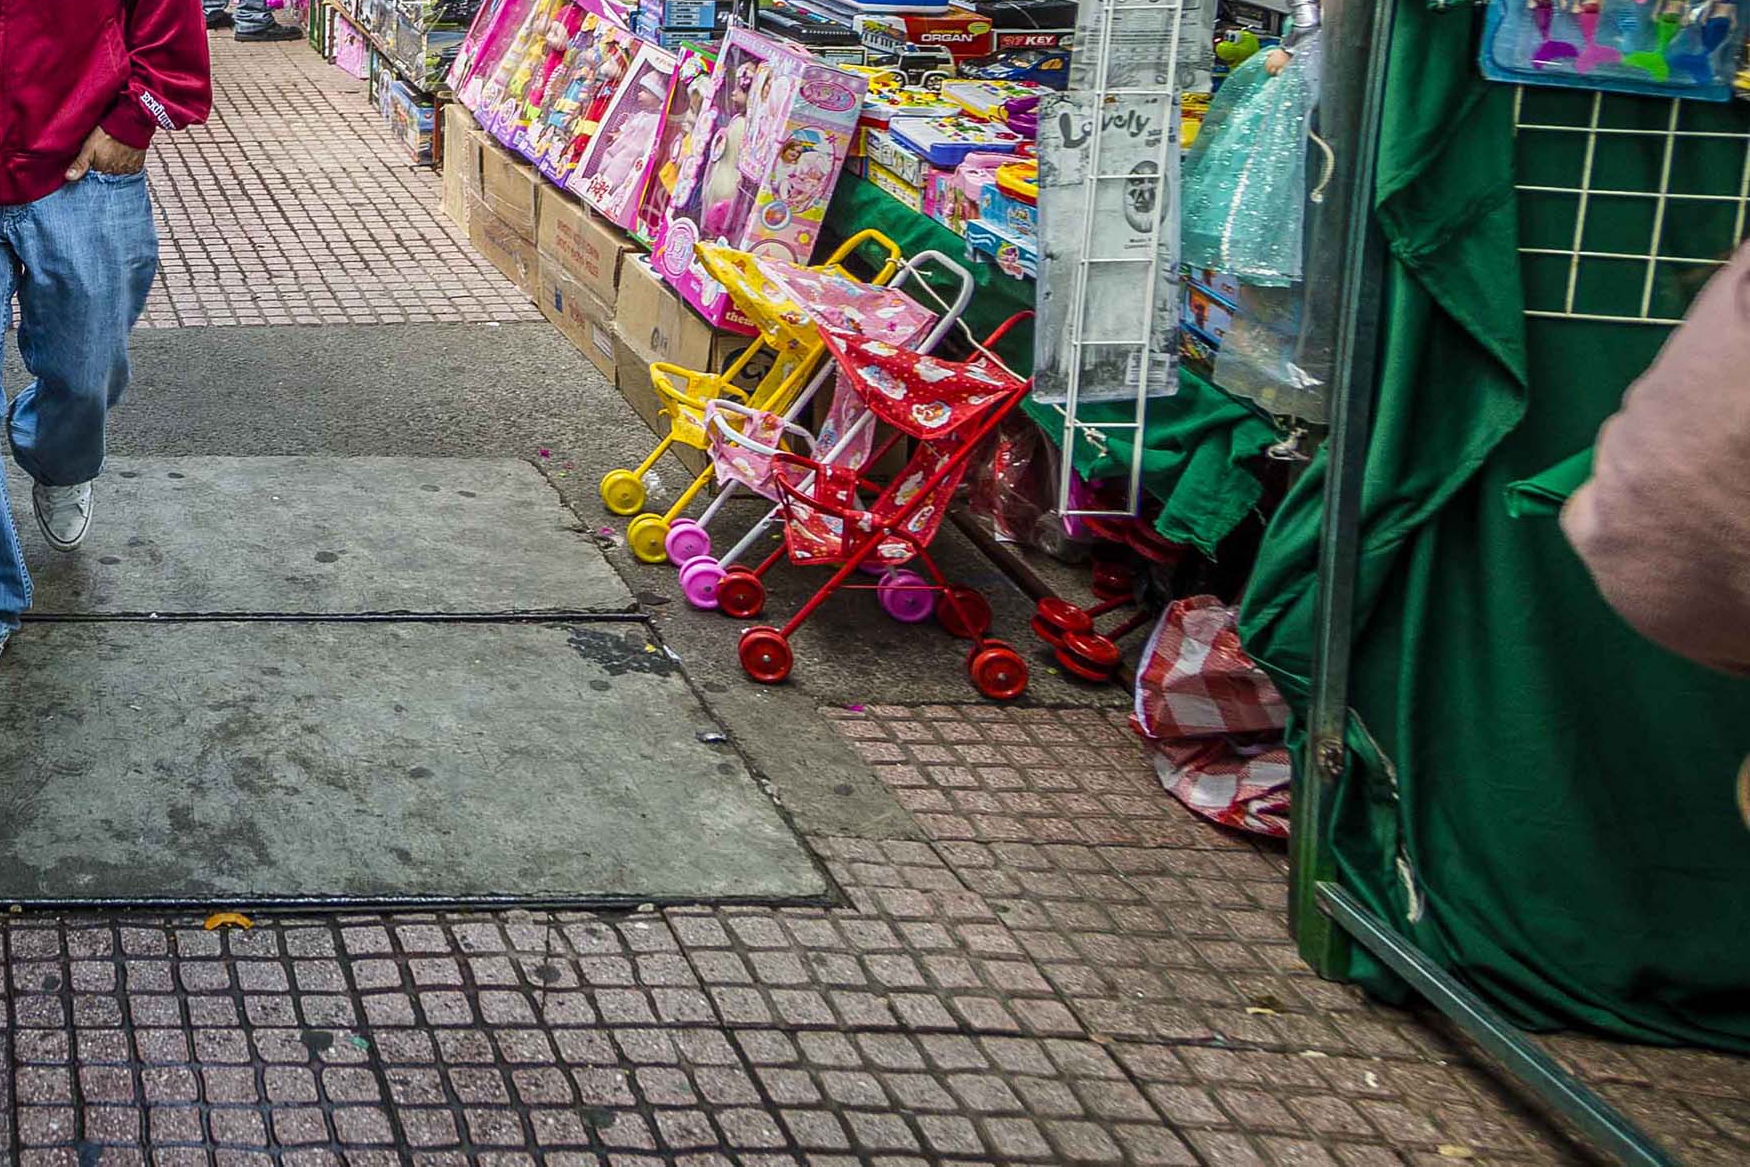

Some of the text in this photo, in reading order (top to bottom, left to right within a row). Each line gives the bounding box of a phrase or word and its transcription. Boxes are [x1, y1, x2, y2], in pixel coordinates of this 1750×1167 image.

[921, 34, 973, 42] ORGAN
[1025, 35, 1052, 46] KEY
[1058, 109, 1151, 150] Lovely
